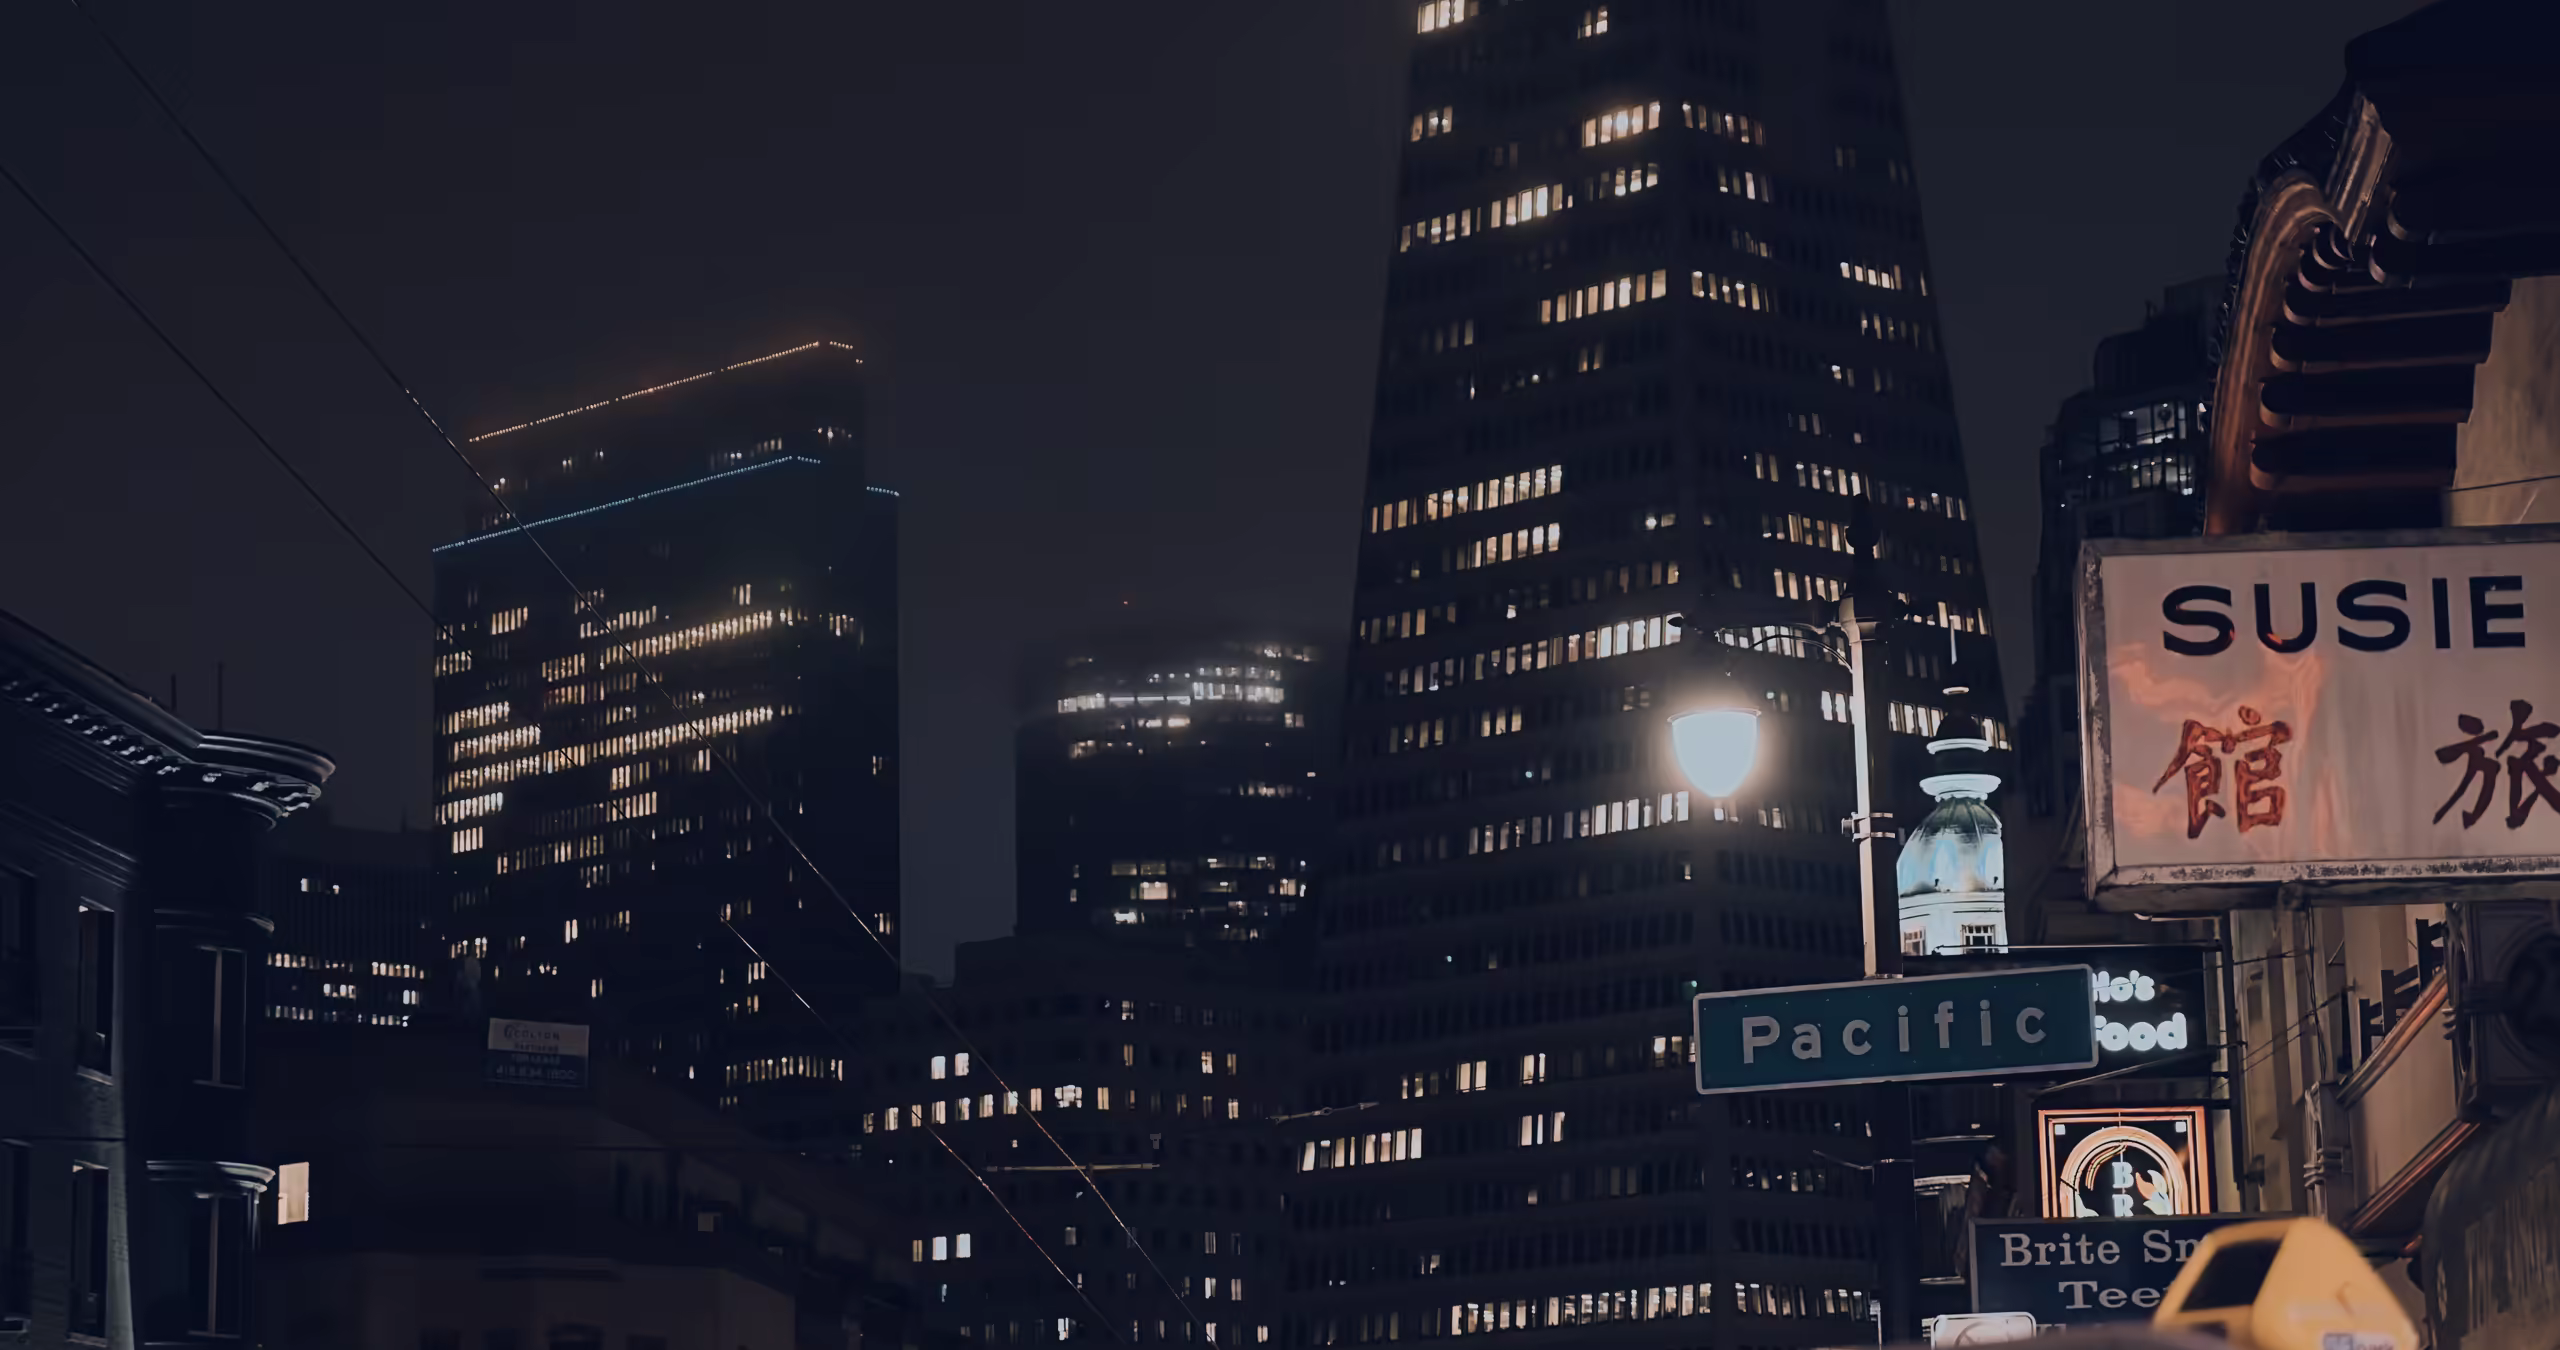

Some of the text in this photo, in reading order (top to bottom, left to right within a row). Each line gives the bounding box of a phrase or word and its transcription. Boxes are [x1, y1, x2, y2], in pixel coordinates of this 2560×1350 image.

[2162, 575, 2526, 656] SUSIE
[1742, 1000, 2047, 1064] Pacific
[1999, 1232, 2121, 1267] Brite
[2059, 1280, 2168, 1309] Tee
